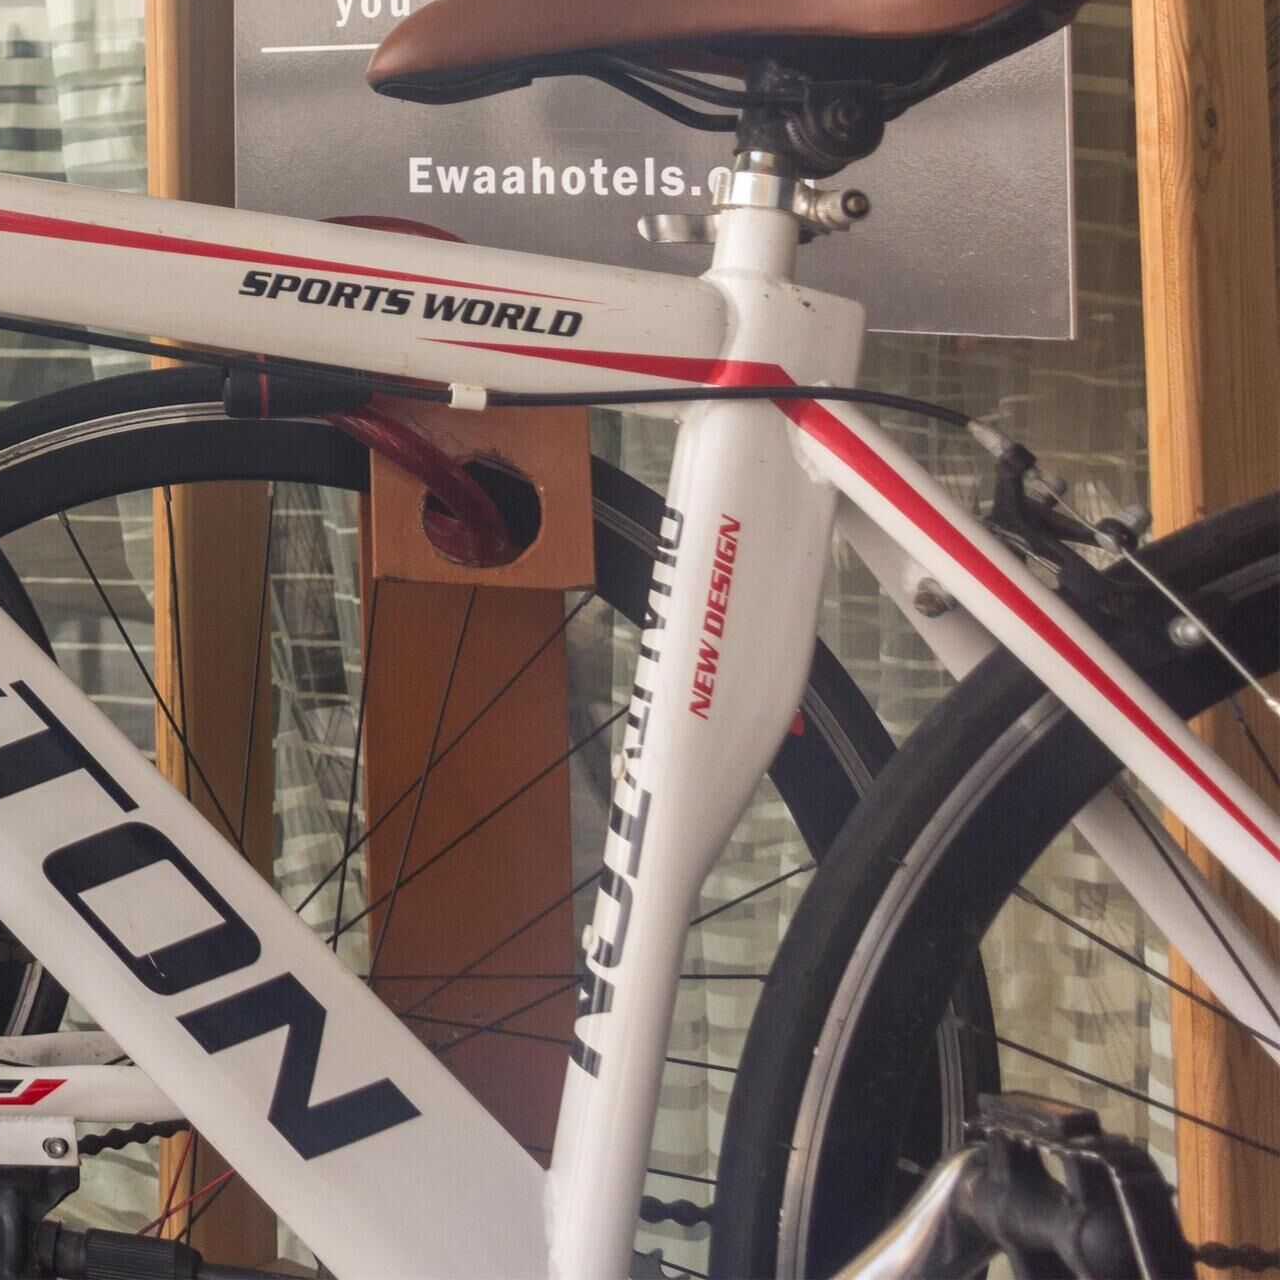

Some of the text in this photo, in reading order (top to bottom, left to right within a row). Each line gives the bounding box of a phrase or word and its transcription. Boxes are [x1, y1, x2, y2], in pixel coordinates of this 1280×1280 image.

[239, 270, 583, 338] SPORTS WORLD
[689, 513, 742, 720] NEW DESIGN
